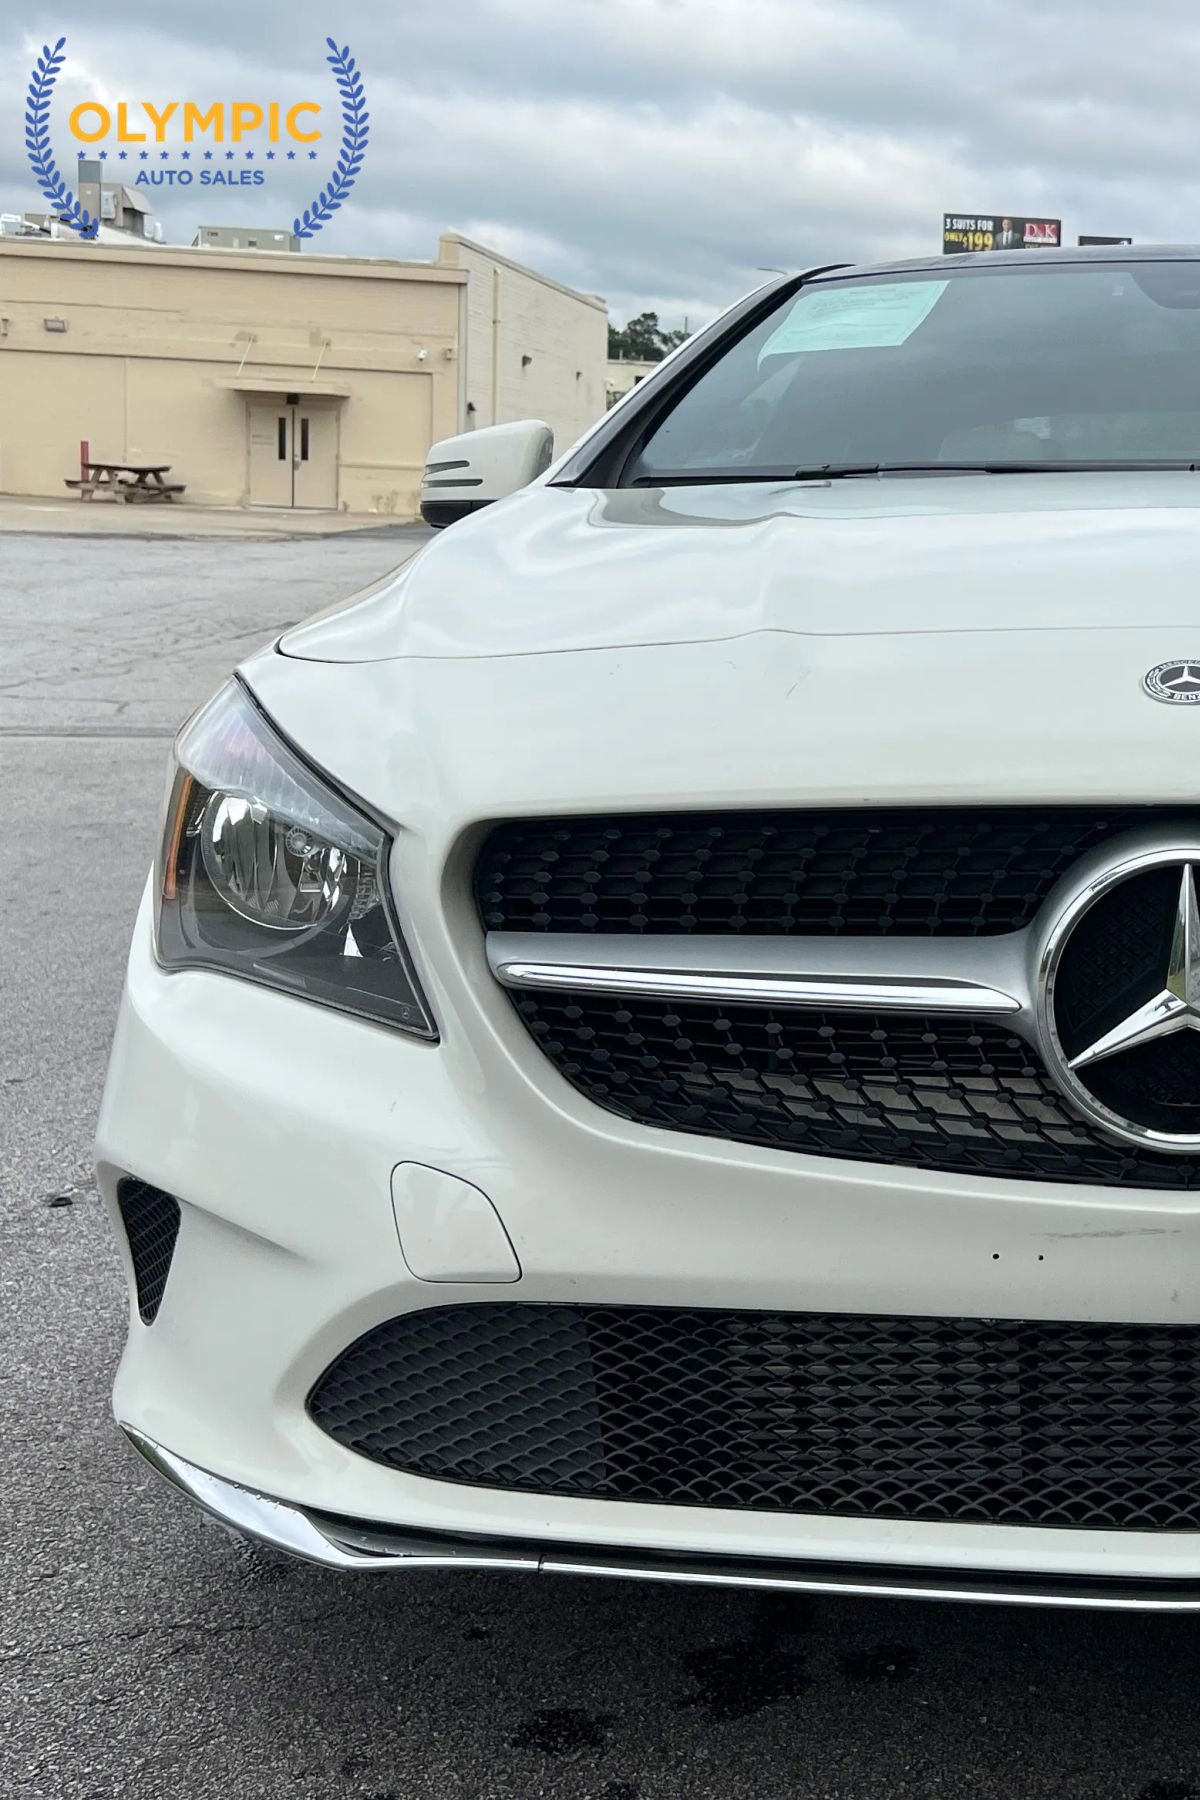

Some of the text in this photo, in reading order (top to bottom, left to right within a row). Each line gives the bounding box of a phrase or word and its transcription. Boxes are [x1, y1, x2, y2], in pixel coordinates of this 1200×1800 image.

[945, 218, 994, 231] 3 SUITS FOR
[944, 231, 964, 242] ONLY
